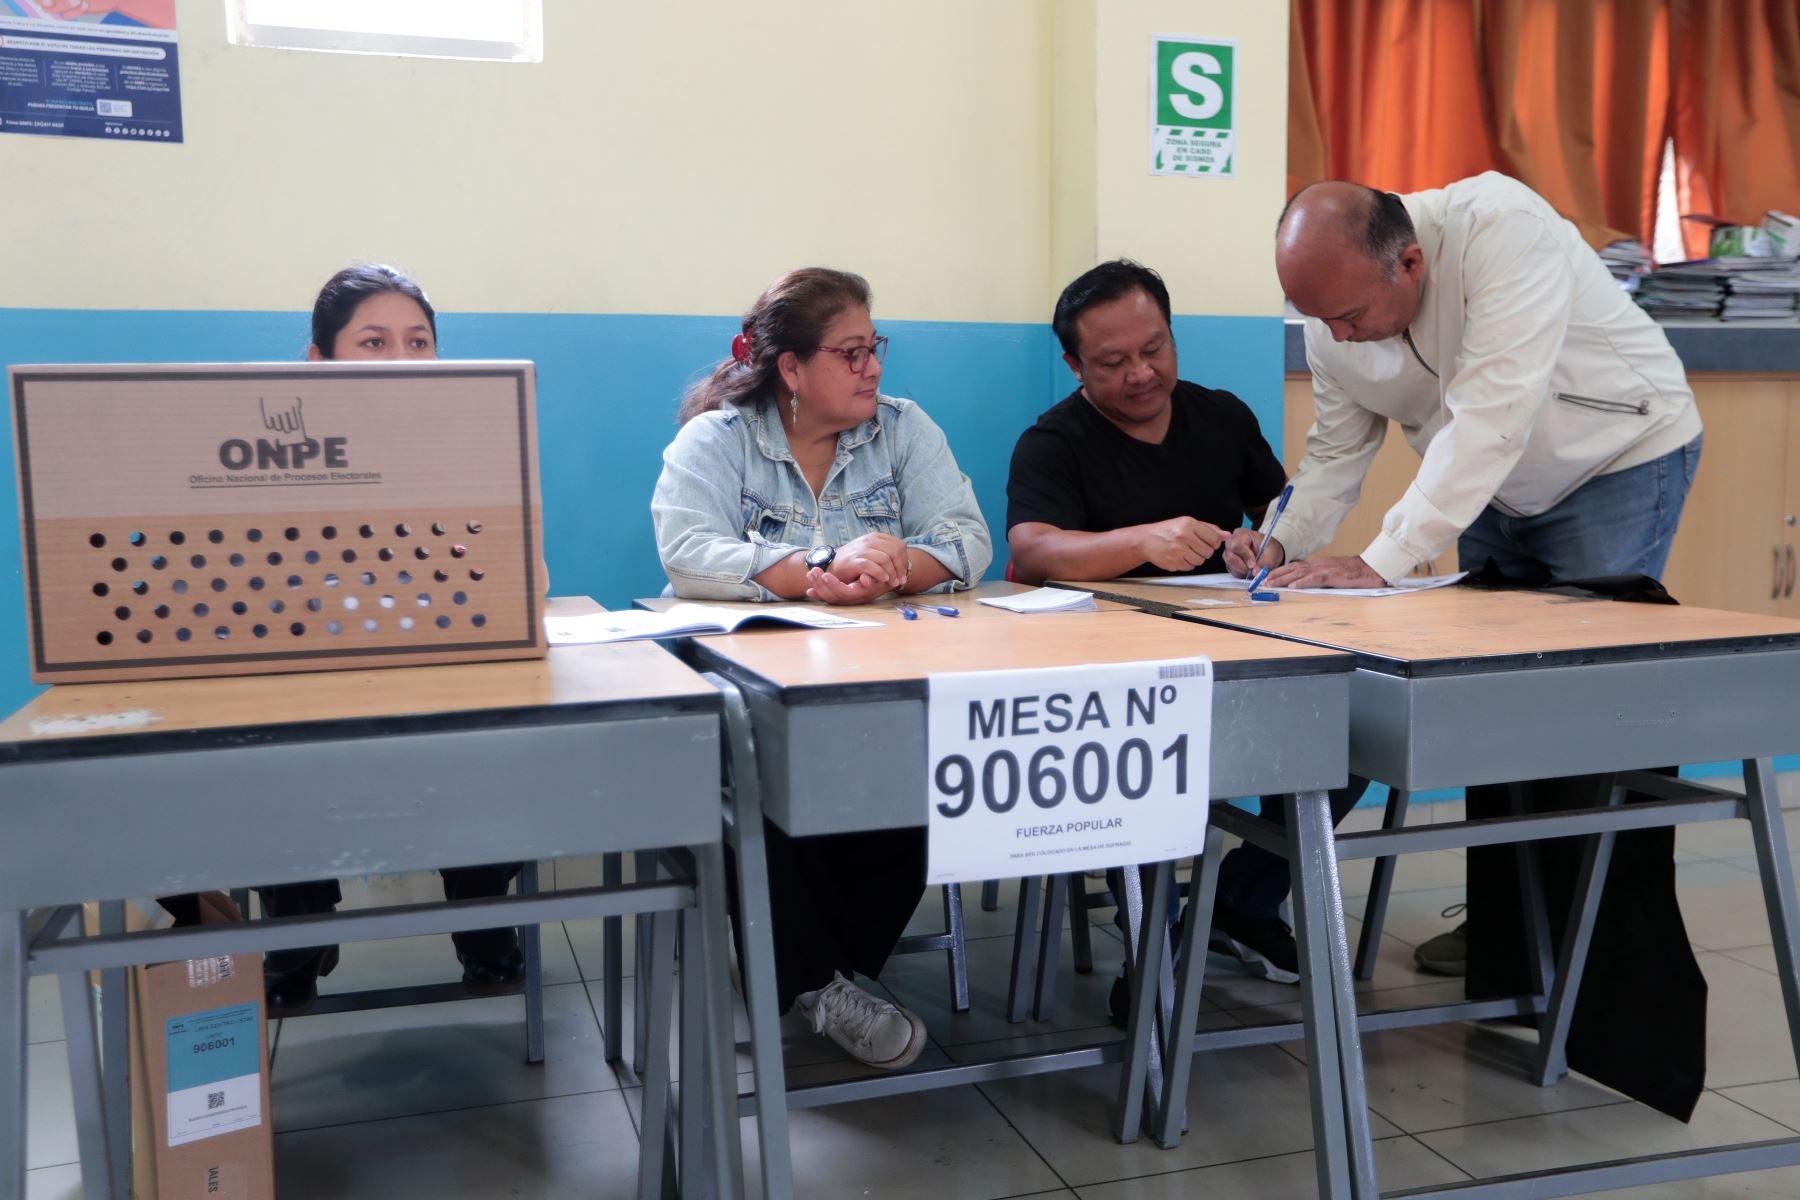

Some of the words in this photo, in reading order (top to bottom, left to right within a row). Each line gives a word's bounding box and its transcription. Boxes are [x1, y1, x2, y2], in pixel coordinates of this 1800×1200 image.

[1168, 51, 1224, 120] S
[1166, 138, 1188, 146] ZONA
[1190, 139, 1222, 147] SEGURA
[1190, 147, 1212, 155] CASO
[1186, 155, 1215, 163] SISMOS
[219, 437, 349, 470] ONPE
[190, 474, 224, 483] Oficina
[226, 473, 267, 482] Nacional
[270, 473, 282, 481] de
[284, 472, 328, 481] Procesos
[330, 471, 381, 480] Electorales
[968, 690, 1111, 741] MESA
[934, 733, 1189, 819] 906001
[1016, 824, 1063, 839] FUERZA
[1066, 817, 1123, 832] POPULAR
[1036, 848, 1066, 857] COLOCADO
[192, 1037, 235, 1054] 906001
